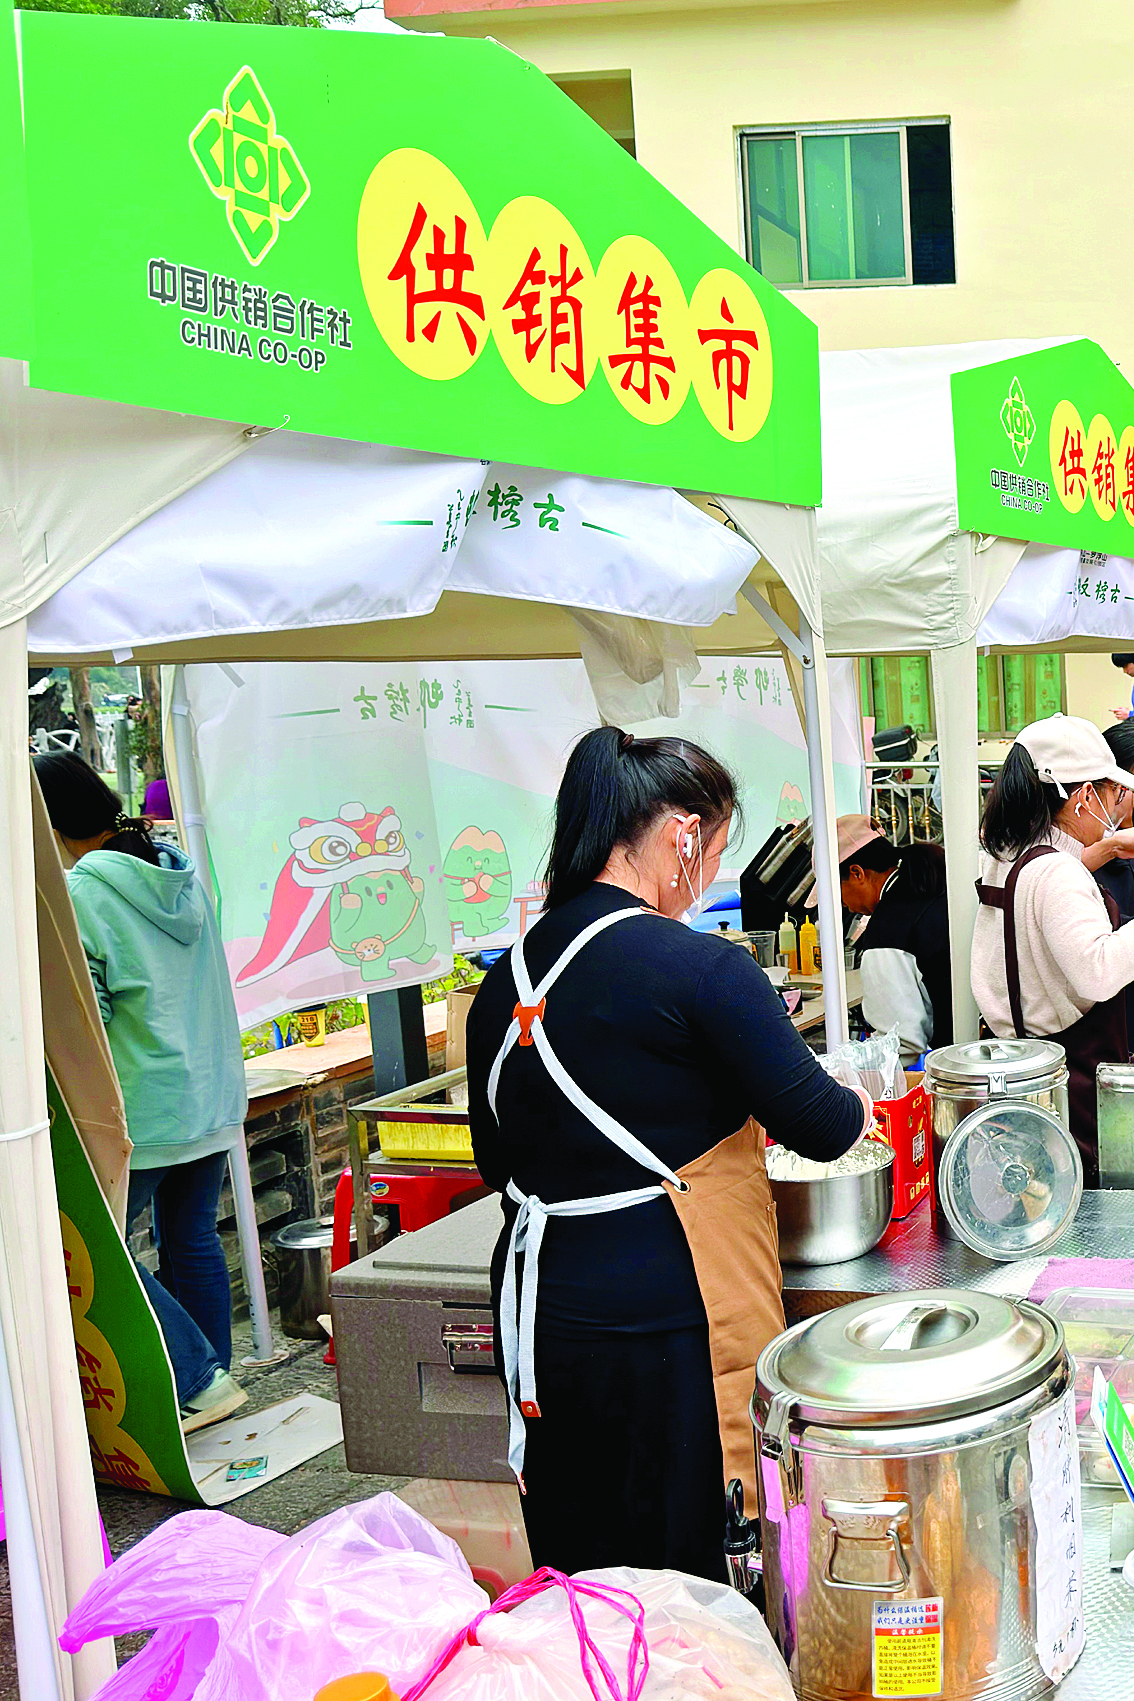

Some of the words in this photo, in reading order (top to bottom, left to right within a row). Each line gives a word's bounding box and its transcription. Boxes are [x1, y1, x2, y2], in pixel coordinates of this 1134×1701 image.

[148, 259, 352, 349] 中国供销合作社
[387, 202, 759, 432] 供销集市
[181, 319, 253, 358] CHINA
[257, 338, 326, 372] CO-OP
[990, 468, 1050, 502] 中国供销合作社
[1000, 494, 1023, 510] CHINA
[1022, 498, 1044, 514] CO-OP
